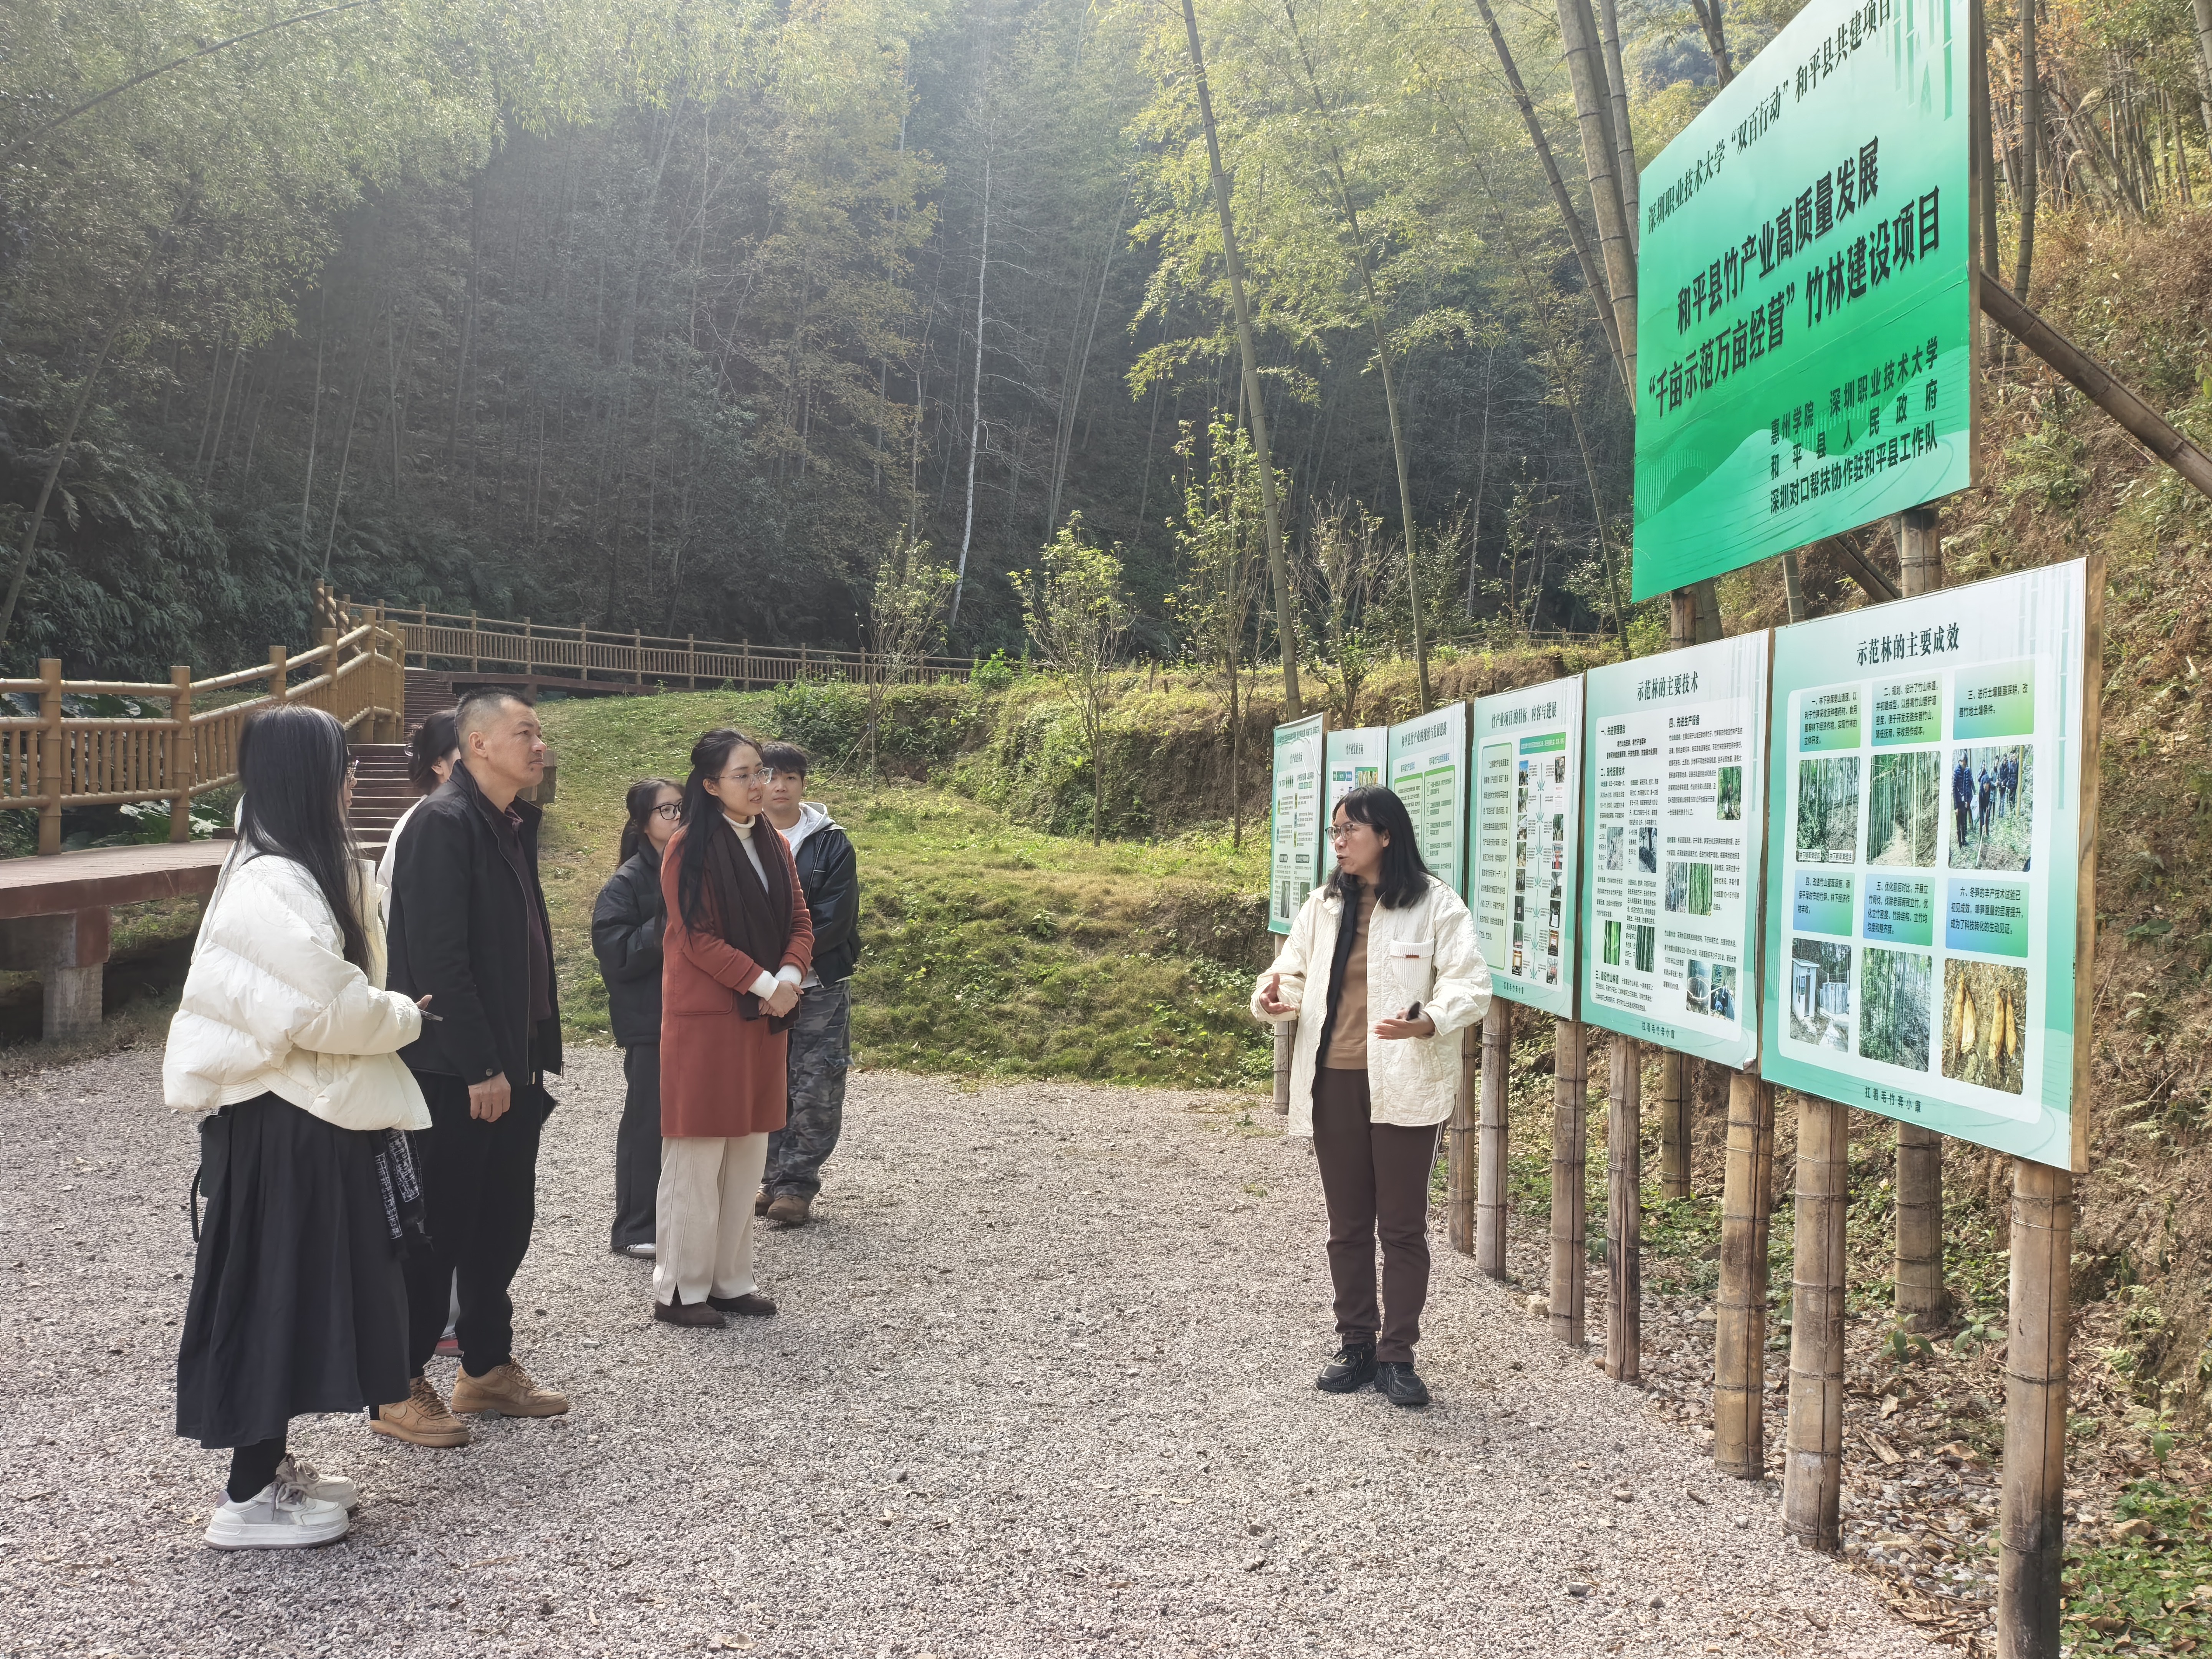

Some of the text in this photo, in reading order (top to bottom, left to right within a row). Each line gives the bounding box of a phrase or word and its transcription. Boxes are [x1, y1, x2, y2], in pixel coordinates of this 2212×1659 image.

[1677, 136, 1879, 336] 和平县竹产业高质量发展
[1649, 185, 1939, 419] “千亩示范万亩经营”竹林建设项目
[1771, 335, 1938, 445] 惠州学院 深圳职业技术大学
[1770, 420, 1938, 515] 深圳对口帮扶协作驻和平县工作队
[1637, 671, 1699, 702] 示范林的主要技术
[1857, 622, 1960, 667] 示范林的主要成效
[1960, 886, 2021, 901] 六、冬笋的丰产技术试验已
